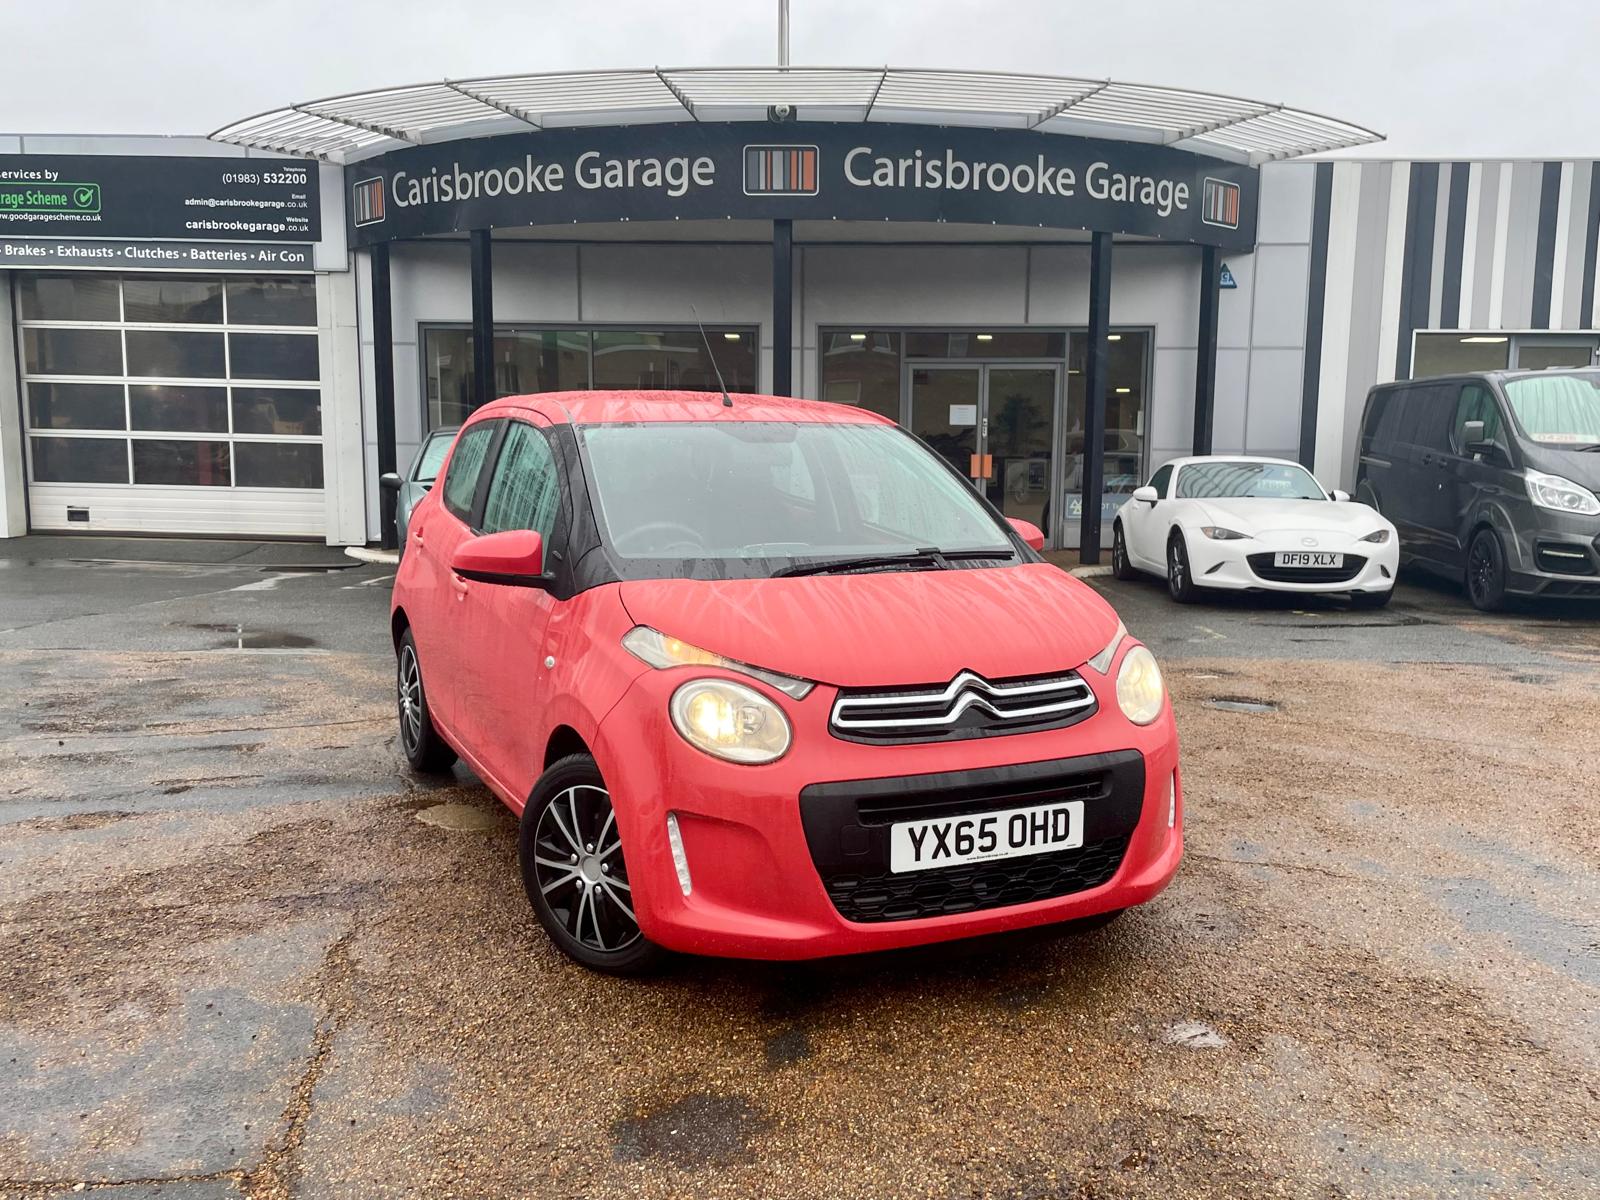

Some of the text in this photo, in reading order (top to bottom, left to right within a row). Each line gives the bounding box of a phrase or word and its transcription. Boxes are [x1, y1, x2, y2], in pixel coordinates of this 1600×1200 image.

[0, 169, 59, 181] ervices by
[222, 172, 307, 185] (01983) 532200
[391, 151, 715, 208] Carisbrooke Garage
[843, 146, 1190, 217] Carisbrooke Garage
[26, 190, 68, 206] Scheme
[185, 198, 308, 209] admin@carisbrookegarage.co.uk
[0, 212, 102, 222] w.goodgaragescheme.co.uk
[185, 220, 309, 233] carisbrookegarage.co.uk
[5, 244, 305, 262] Brakes Exhausts Clutches Batteries Air Con
[1282, 553, 1336, 565] DF19 XLX
[908, 808, 1070, 862] YX65 OHD
